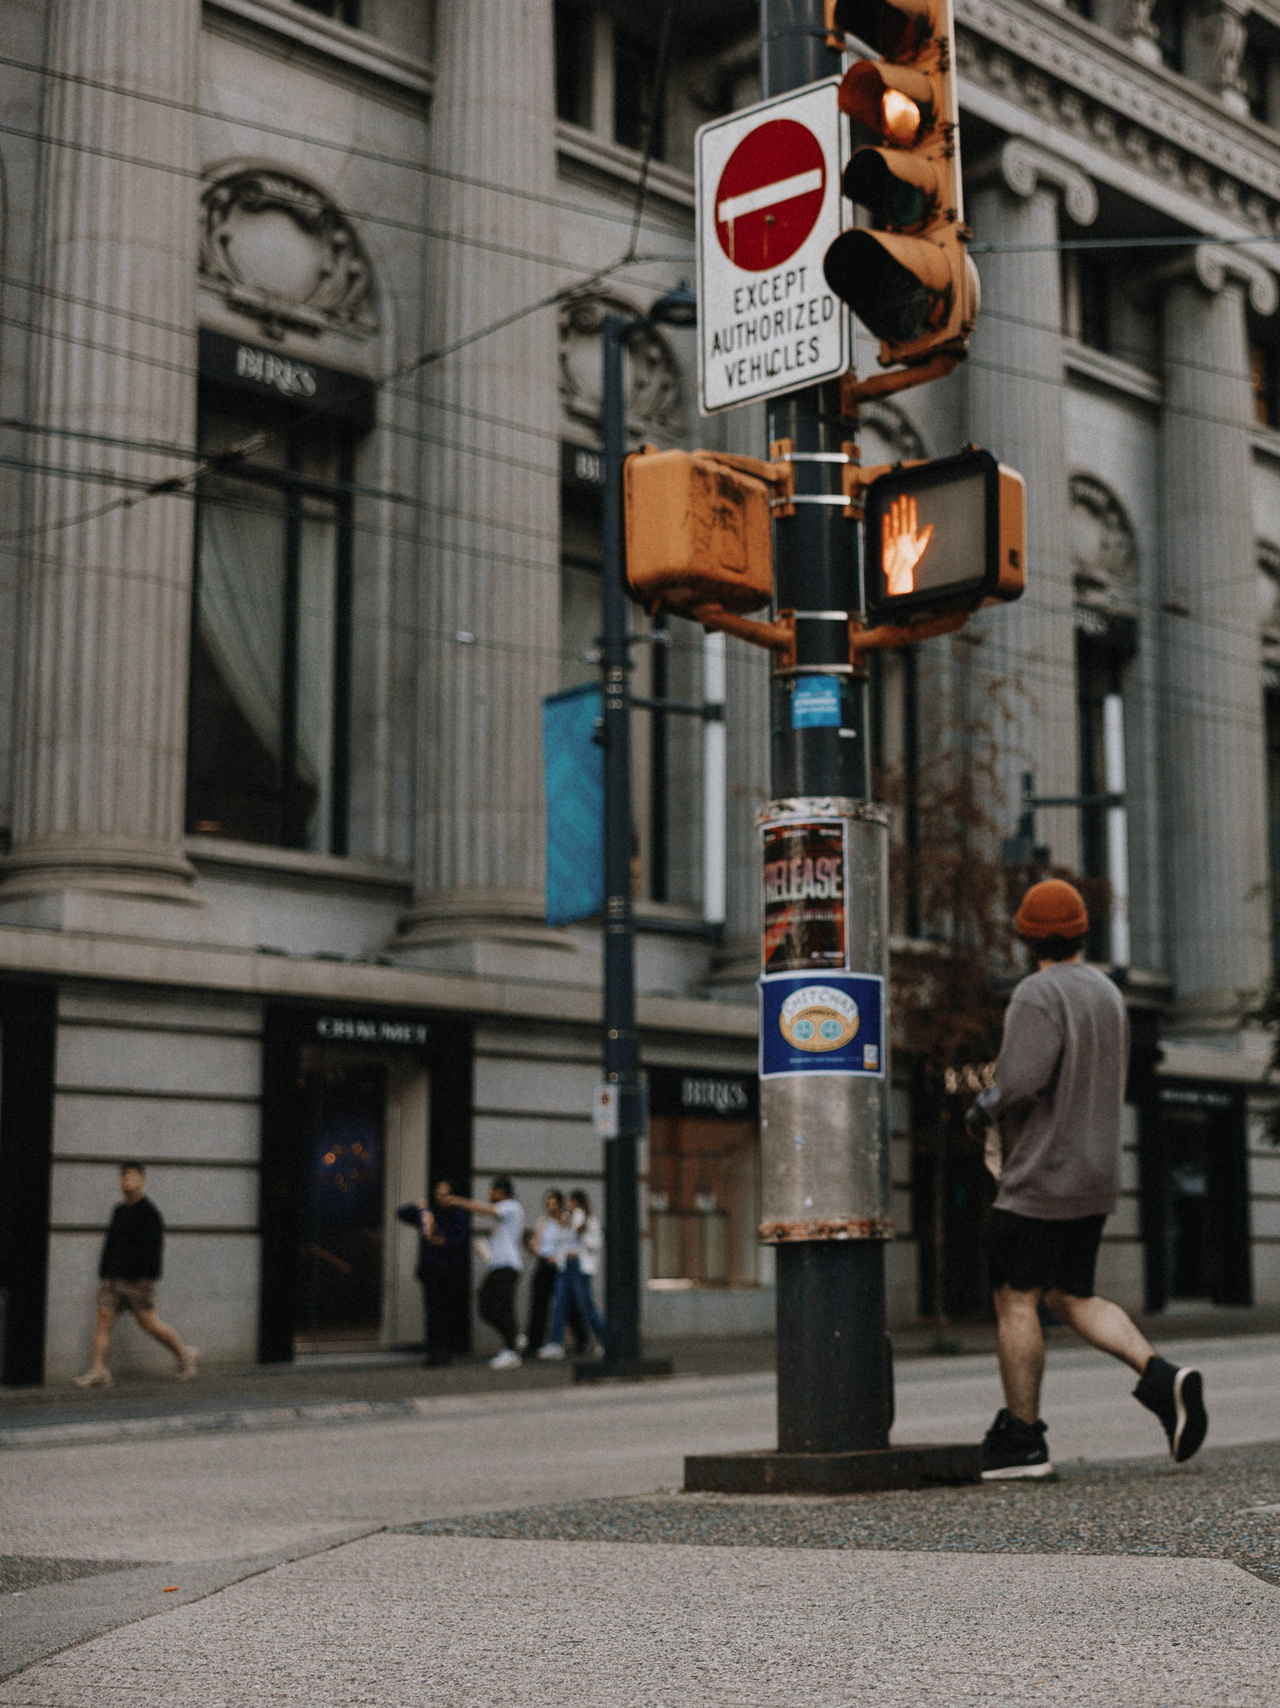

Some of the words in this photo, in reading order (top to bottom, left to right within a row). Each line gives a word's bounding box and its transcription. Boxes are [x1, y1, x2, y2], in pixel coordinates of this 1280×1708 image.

[734, 266, 808, 315] EXCEPT
[711, 295, 834, 357] AUTHORIZED
[236, 345, 317, 397] BIRKS
[725, 335, 821, 389] VEHICLES
[765, 855, 844, 905] RELEASE
[316, 1017, 427, 1046] CHAUMET
[682, 1077, 748, 1113] BIRKS
